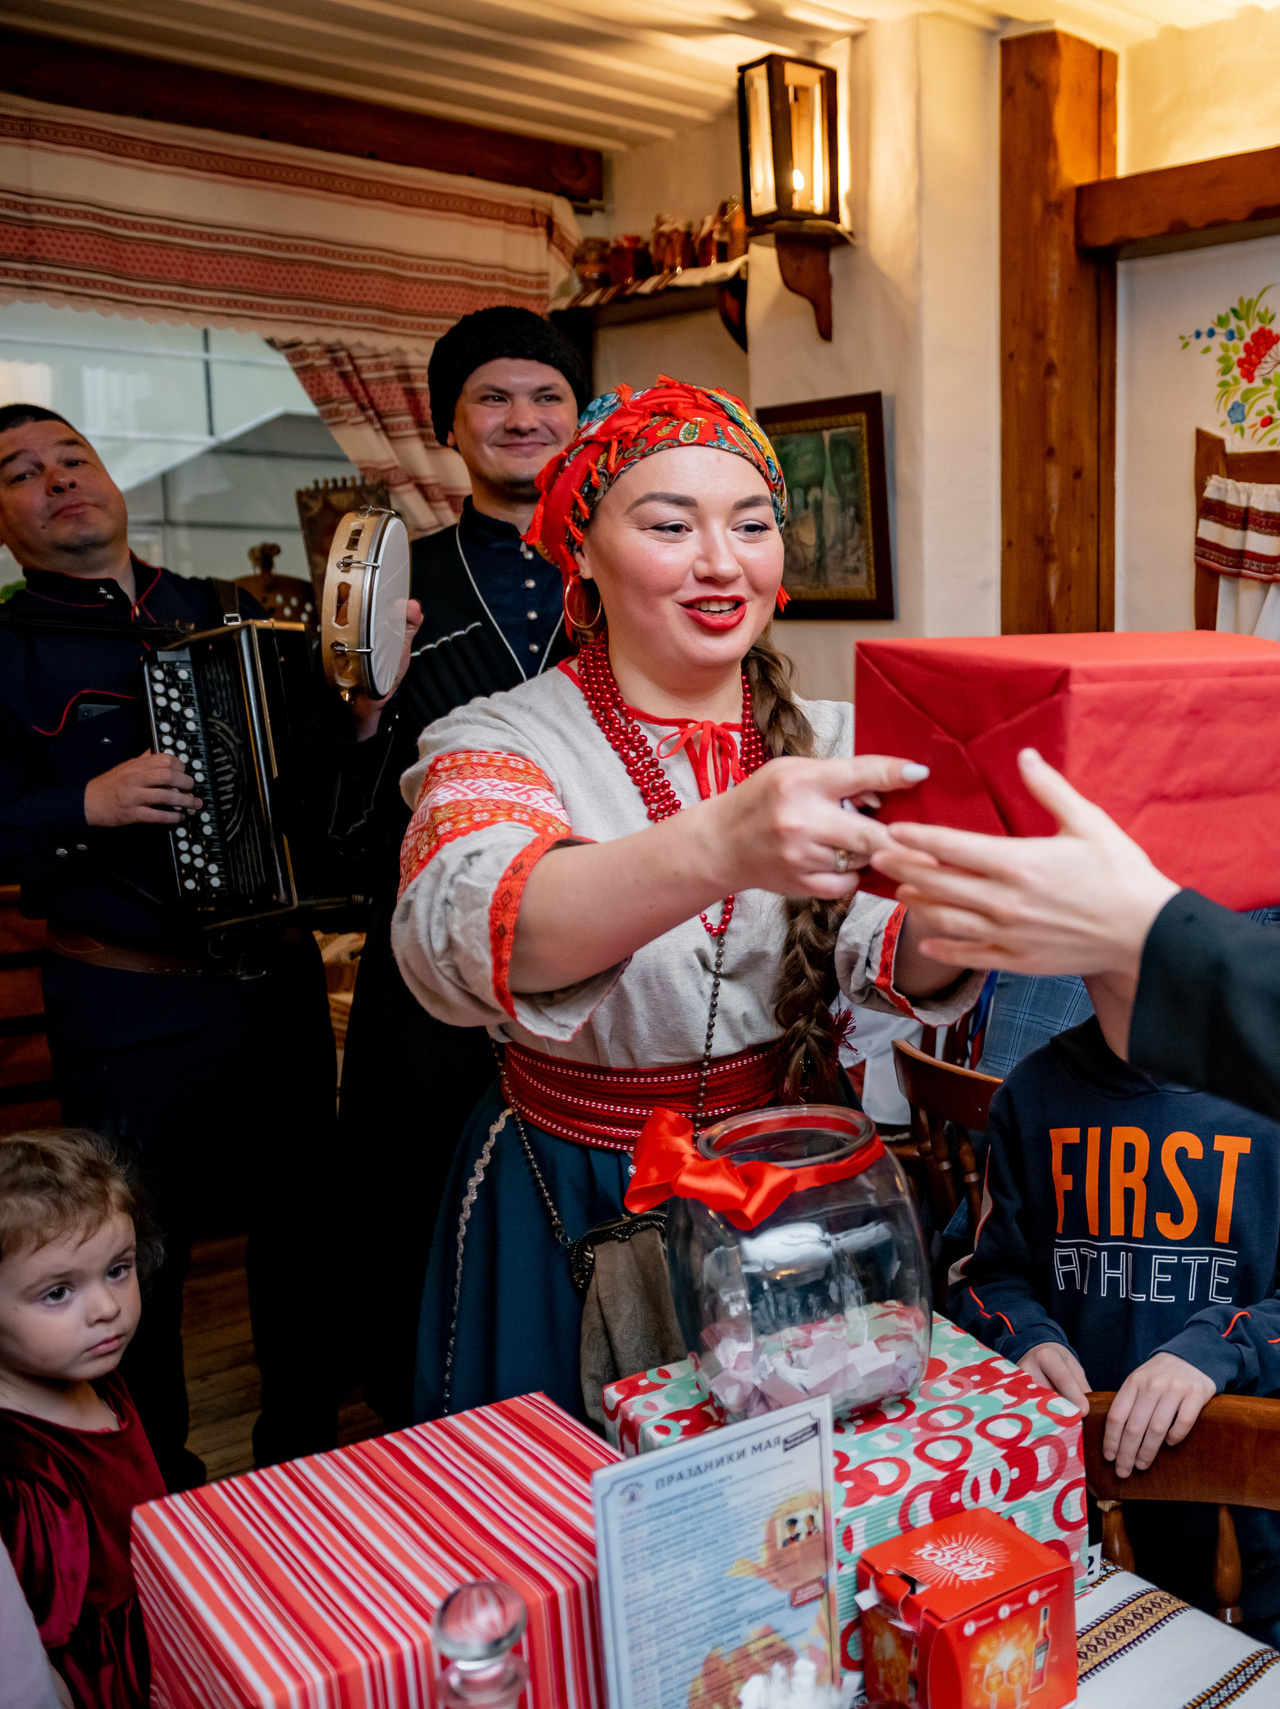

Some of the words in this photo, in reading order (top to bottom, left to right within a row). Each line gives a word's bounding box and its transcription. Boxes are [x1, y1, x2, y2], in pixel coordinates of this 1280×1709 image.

[1049, 1126, 1251, 1243] FIRST
[1054, 1248, 1236, 1303] ATHLETE
[655, 1448, 746, 1491] ПРАЗДНИКИ
[751, 1435, 781, 1456] МАЯ
[914, 1543, 996, 1581] APEROL
